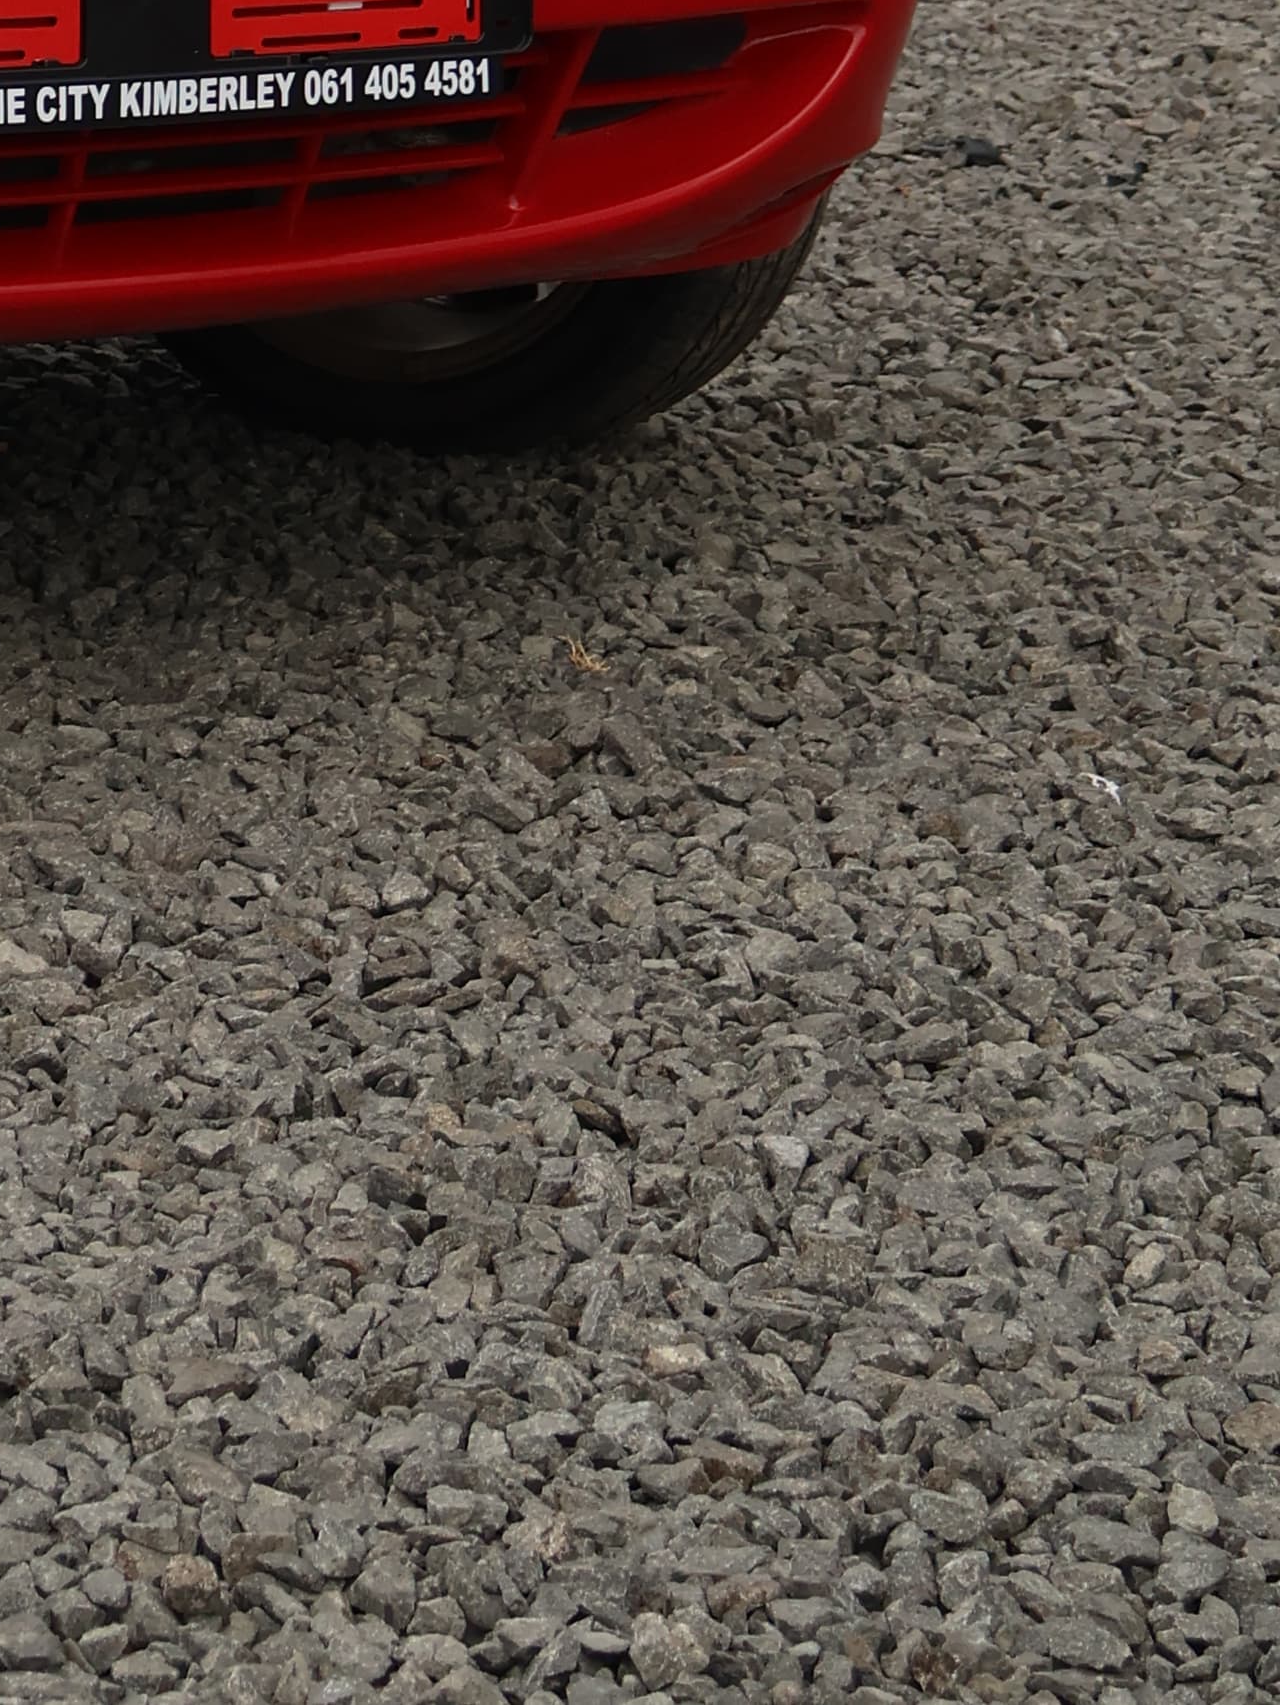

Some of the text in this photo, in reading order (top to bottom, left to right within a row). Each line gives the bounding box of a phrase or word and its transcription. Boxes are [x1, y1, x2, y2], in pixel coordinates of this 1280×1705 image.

[36, 84, 110, 123] CITY
[119, 72, 296, 118] KIMBERLEY
[304, 67, 354, 106] 061
[364, 63, 416, 101] 405
[423, 58, 490, 97] 4581
